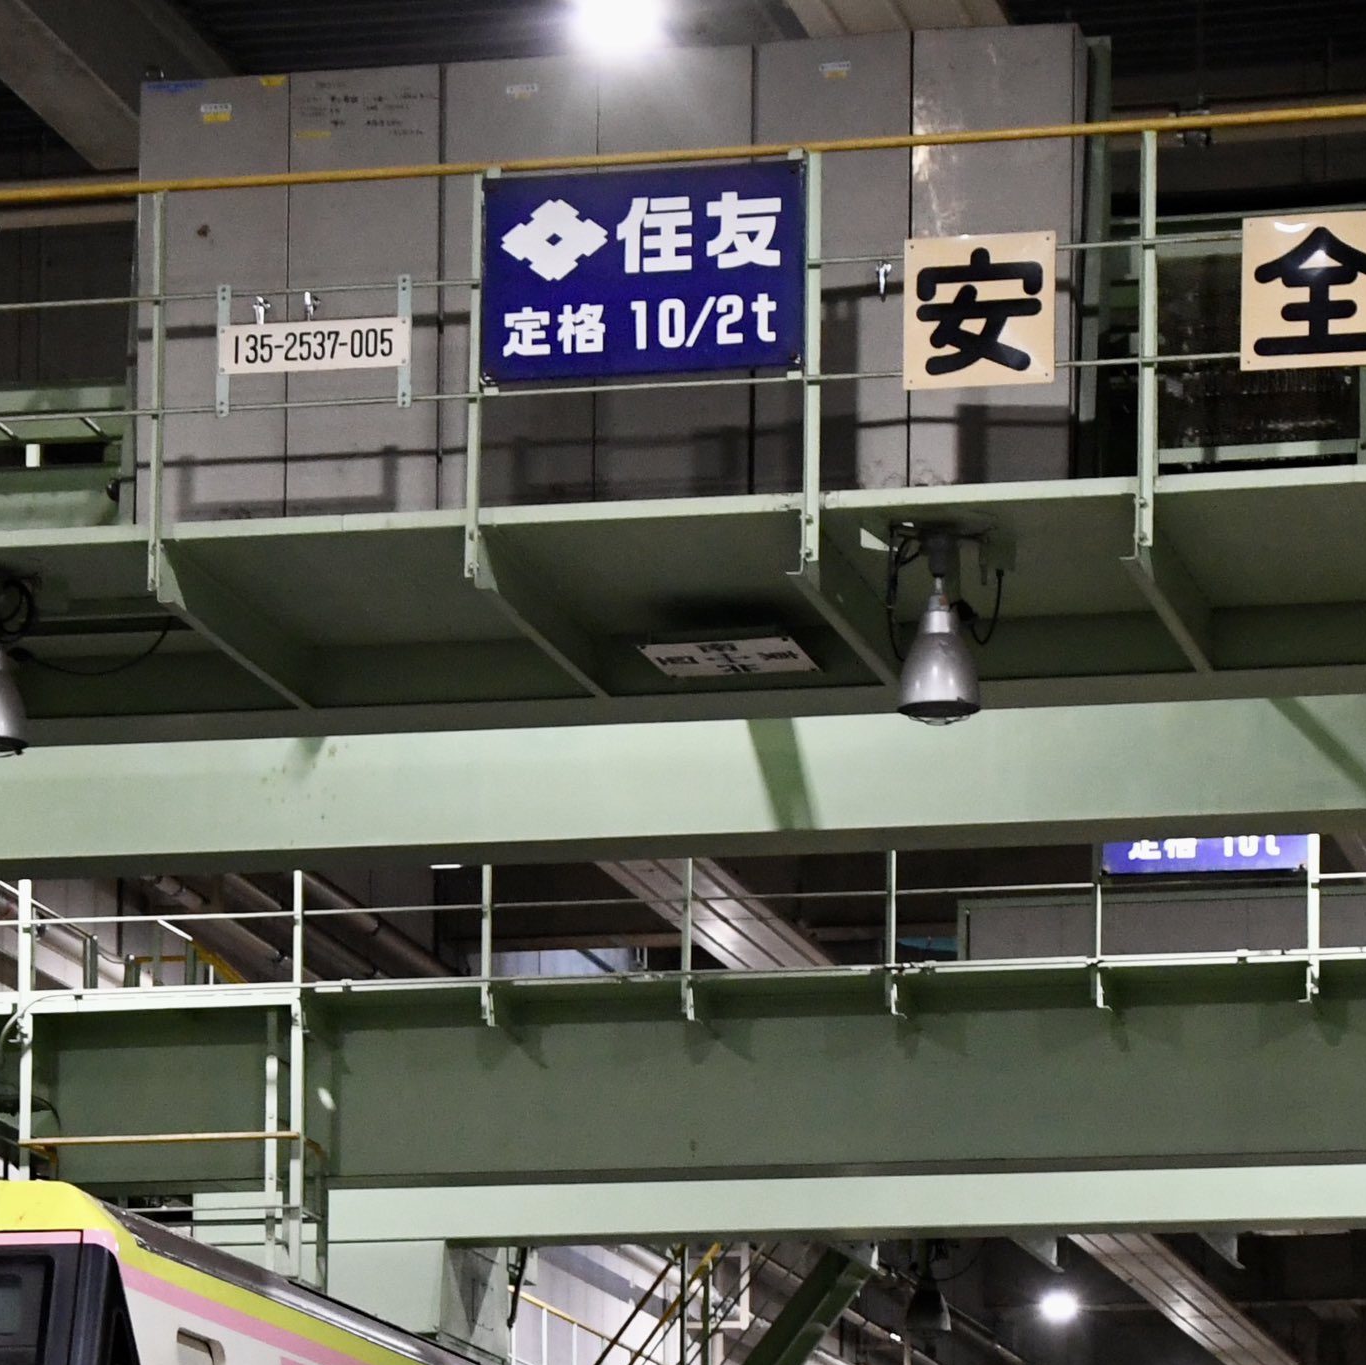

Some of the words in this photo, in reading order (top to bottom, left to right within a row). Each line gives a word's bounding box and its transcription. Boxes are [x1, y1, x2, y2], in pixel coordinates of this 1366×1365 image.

[616, 191, 782, 274] 住友
[234, 328, 394, 364] 135-2537-005
[502, 303, 606, 358] 定格
[630, 293, 777, 350] 10/2t
[916, 247, 1043, 375] 安
